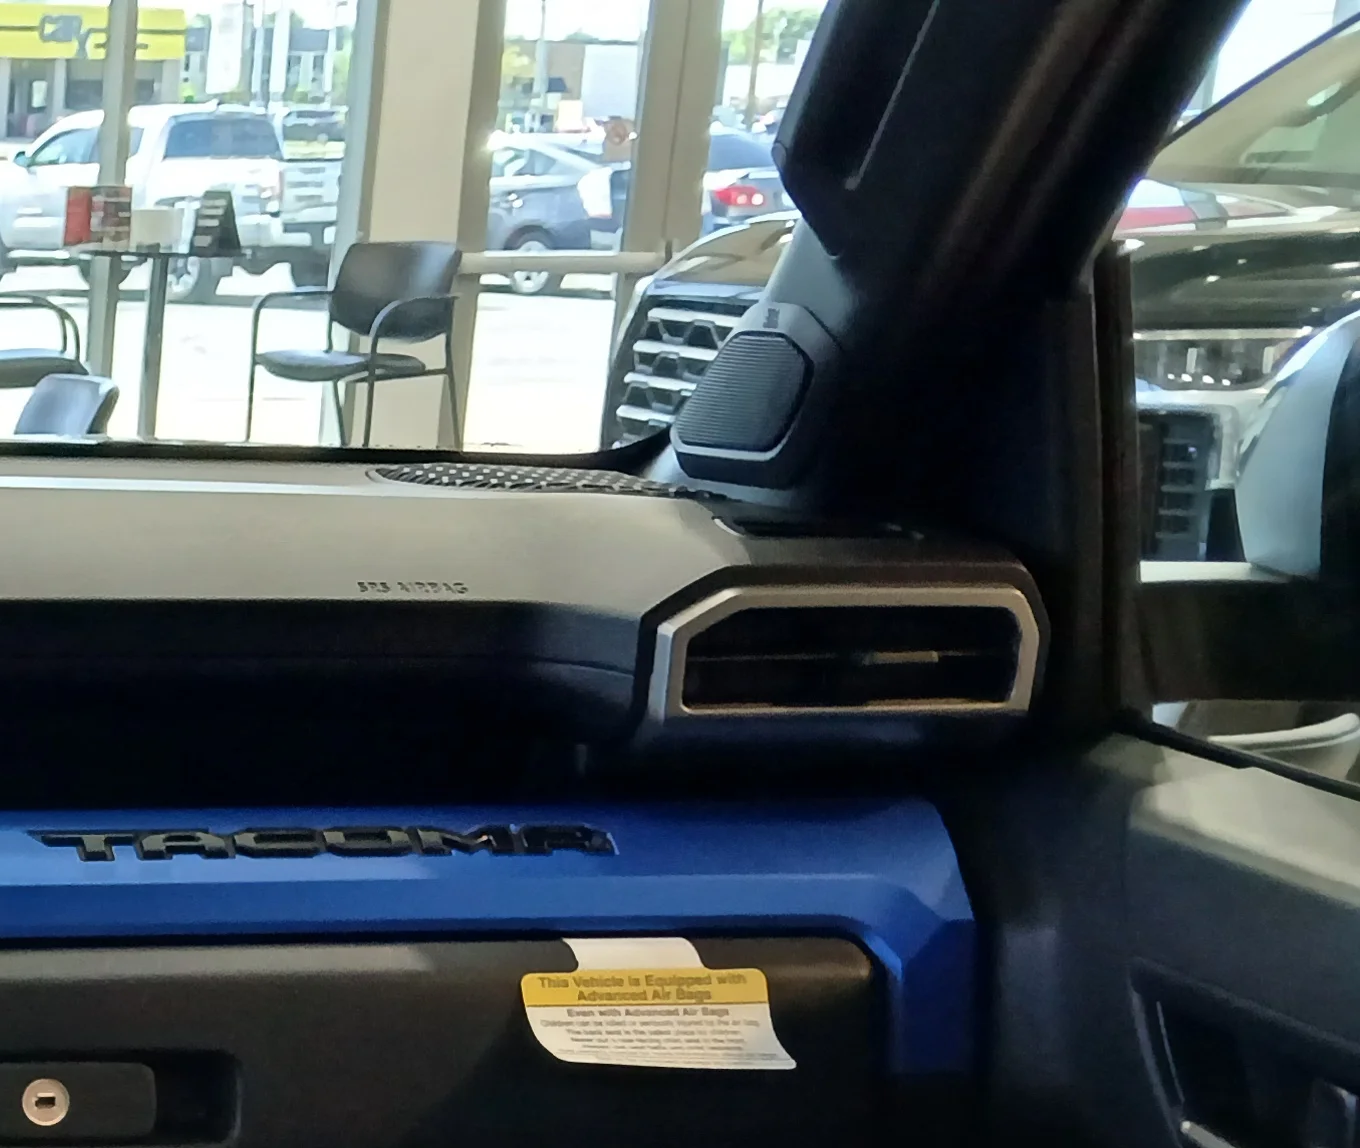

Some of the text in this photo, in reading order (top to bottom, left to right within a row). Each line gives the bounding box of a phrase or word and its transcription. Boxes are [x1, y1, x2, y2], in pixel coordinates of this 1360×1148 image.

[26, 826, 620, 861] TACOMA
[538, 976, 569, 988] This
[572, 975, 625, 987] Vehicle
[645, 974, 712, 989] Equipped
[716, 973, 748, 985] with
[577, 988, 712, 1003] Advanced Air Bags
[566, 1008, 594, 1017] Even
[625, 1008, 679, 1017] Advanced
[683, 1007, 699, 1016] Air
